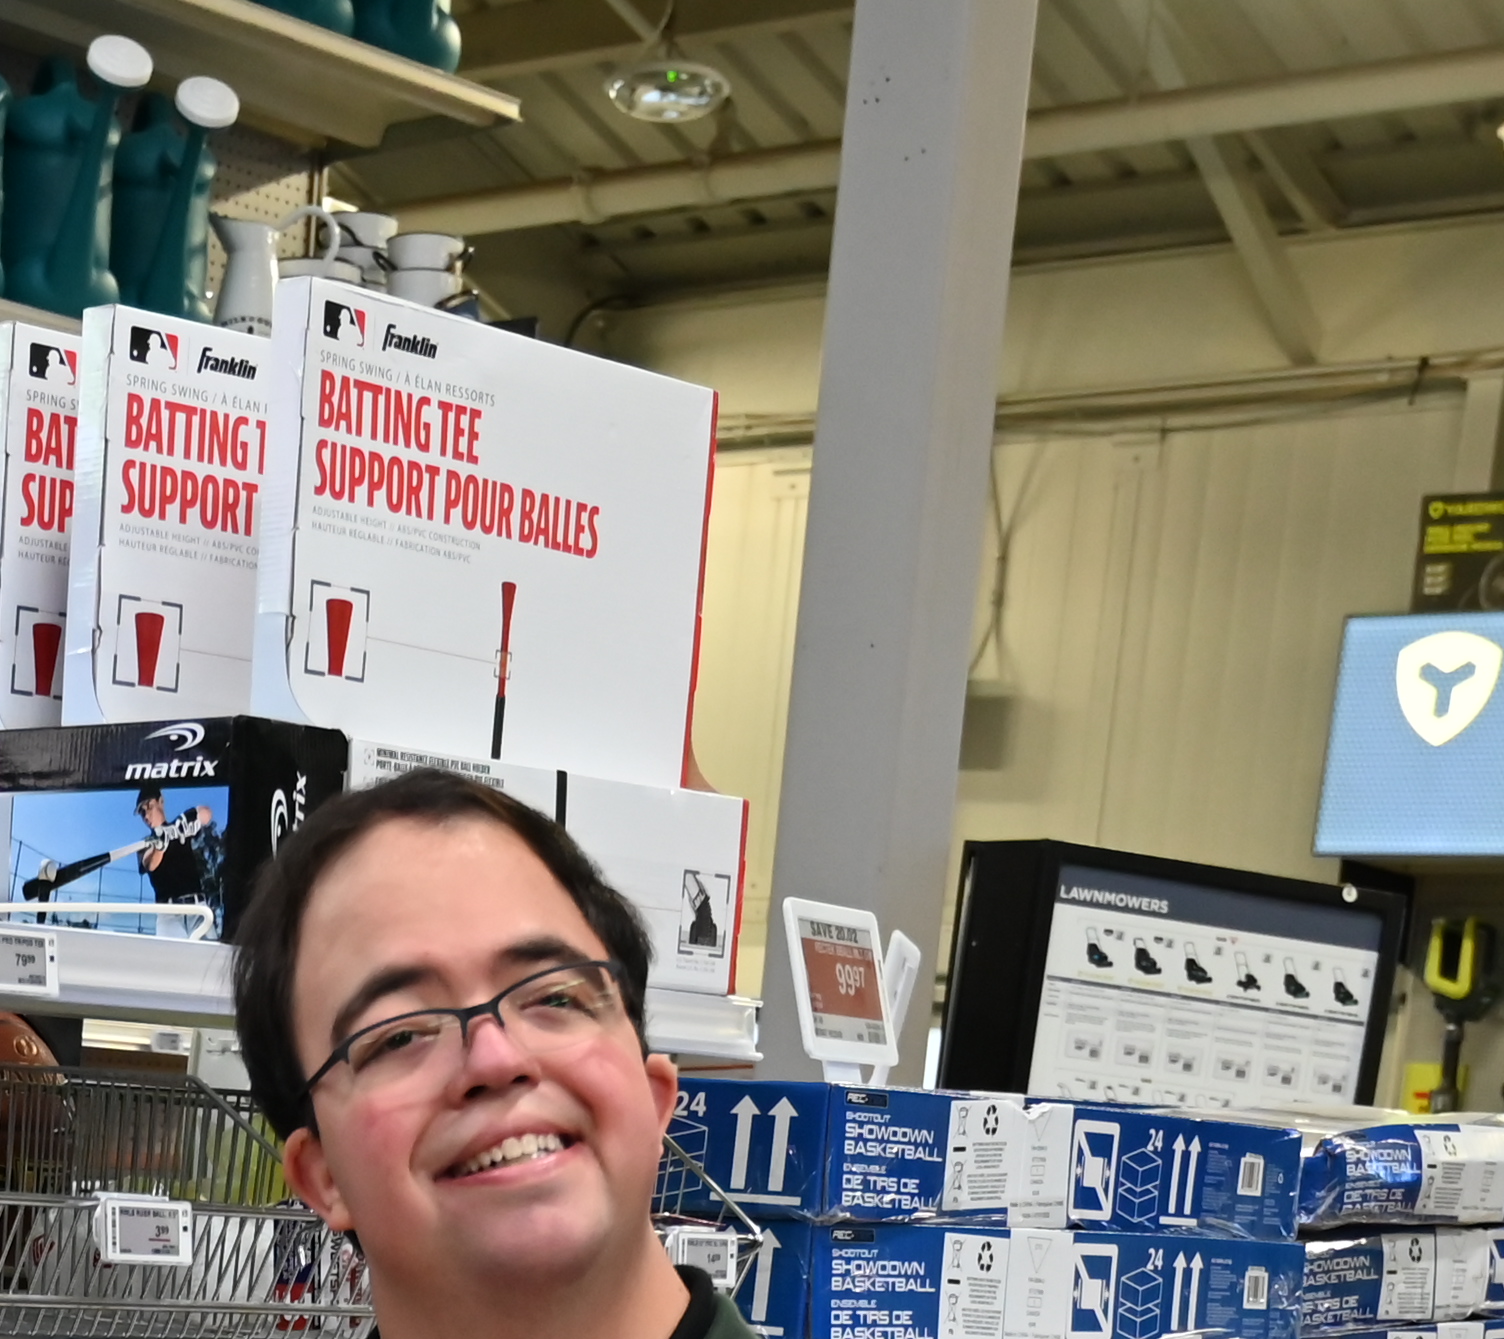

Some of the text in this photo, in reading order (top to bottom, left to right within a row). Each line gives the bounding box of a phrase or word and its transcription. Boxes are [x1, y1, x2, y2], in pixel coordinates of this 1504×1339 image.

[320, 350, 497, 408] SPRING SWING À ÉLAN RESSORTS
[26, 389, 67, 410] SPRING
[126, 373, 168, 394] SPRING
[171, 383, 209, 403] SWING
[232, 395, 261, 414] ÉLAN
[317, 369, 432, 454] BATTING
[437, 399, 482, 465] TEE
[124, 391, 250, 472] BATTING
[120, 459, 260, 538] SUPPORT
[314, 439, 441, 521] SUPPORT
[443, 469, 514, 540] POUR
[518, 488, 600, 559] BALLES
[311, 521, 347, 538] HAUTEUR
[394, 538, 441, 558] FABRICATION
[312, 505, 359, 526] ADJUSTABLE
[360, 514, 388, 530] HEIGHT
[429, 529, 481, 551] CONSTRUCTION
[124, 756, 219, 781] matrix
[1060, 884, 1169, 914] LAWNMOWERS
[809, 920, 834, 941] SAVE
[674, 1090, 708, 1118] 24
[845, 1110, 892, 1124] SHOOTOUT
[844, 1123, 935, 1144] SHOWDOWN
[1146, 1128, 1164, 1152] 24
[844, 1141, 943, 1162] BASKETBALL
[842, 1174, 921, 1194] DE TIRS DE
[841, 1191, 938, 1211] BASKETBALL
[831, 1247, 879, 1259] SHOOTOUT
[1146, 1247, 1165, 1272] 24
[830, 1260, 925, 1276] SHOWDOWN
[830, 1275, 937, 1293] BASKETBALL
[830, 1310, 914, 1326] DE TIRS DE
